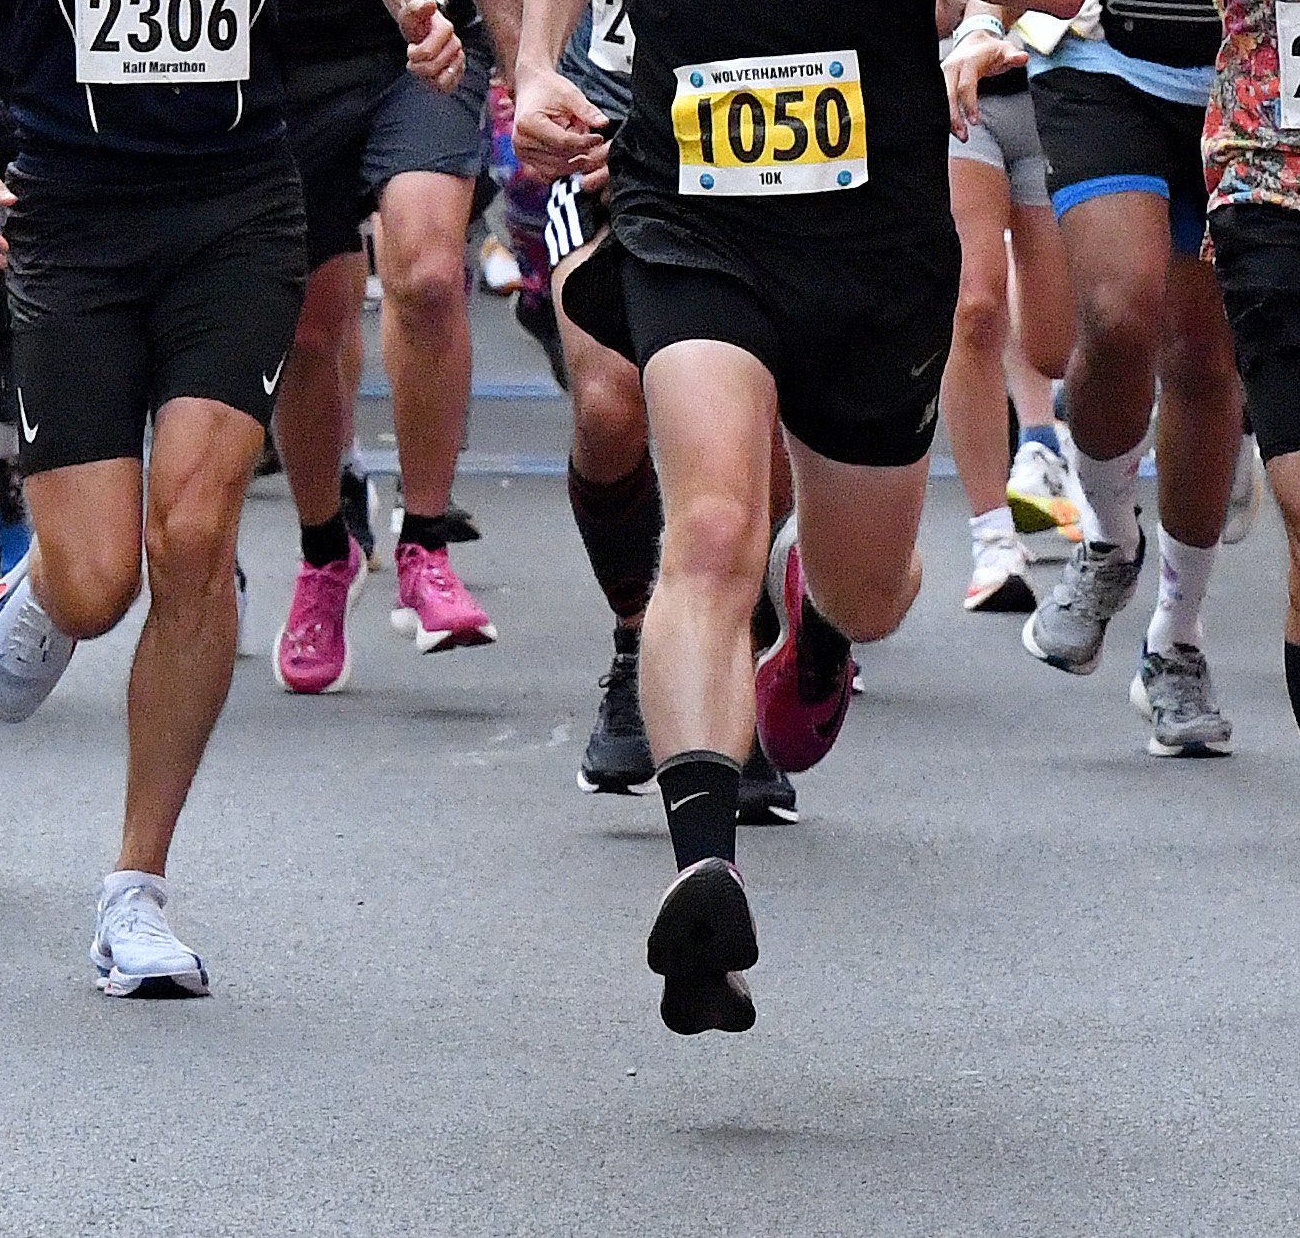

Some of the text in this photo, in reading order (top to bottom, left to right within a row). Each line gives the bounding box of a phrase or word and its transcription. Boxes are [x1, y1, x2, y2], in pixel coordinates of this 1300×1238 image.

[122, 61, 206, 74] Half Marathon
[711, 63, 824, 85] WOLVERHAMPTON
[697, 87, 852, 164] 1050
[759, 171, 783, 185] 10K
